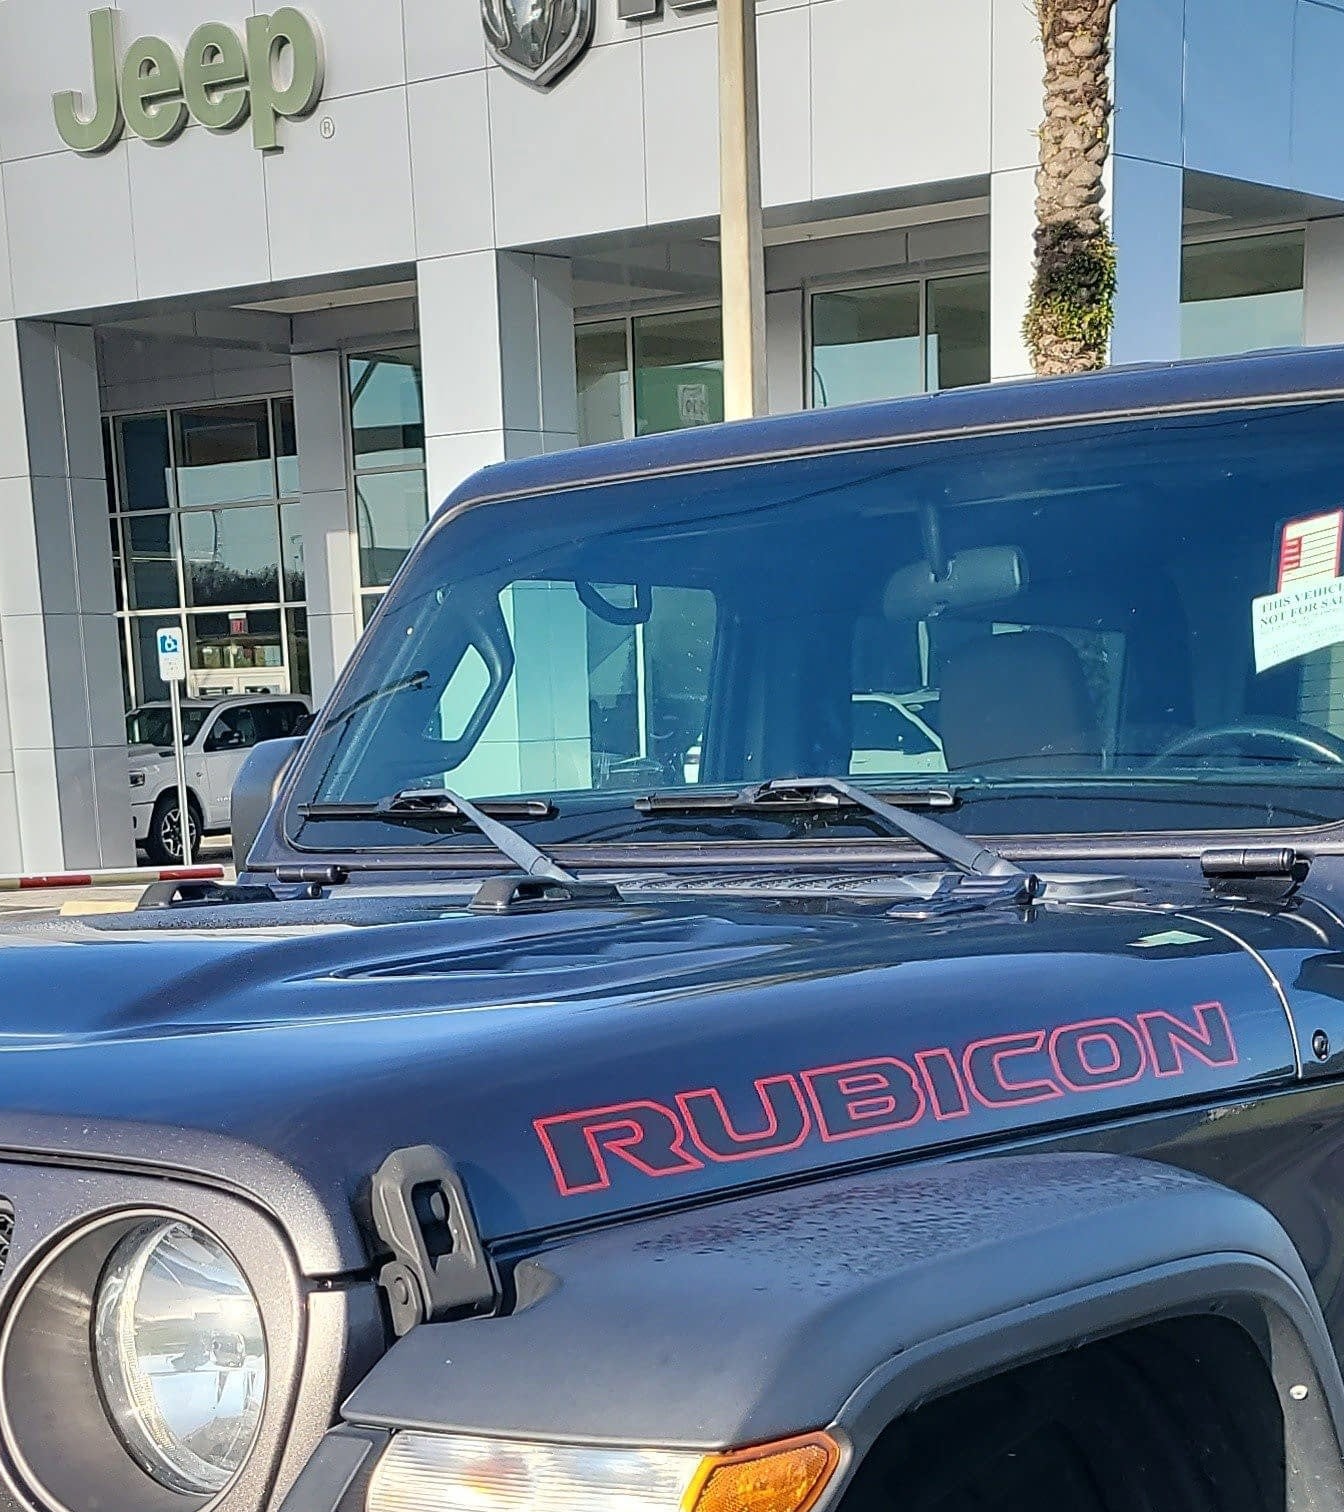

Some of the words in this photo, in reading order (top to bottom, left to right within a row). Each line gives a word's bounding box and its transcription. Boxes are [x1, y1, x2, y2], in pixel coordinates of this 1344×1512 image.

[54, 7, 323, 151] Jeep
[1260, 612, 1284, 625] NOT
[1290, 601, 1317, 618] FOR
[1261, 597, 1291, 613] THIS
[533, 1002, 1238, 1196] RUBICON
